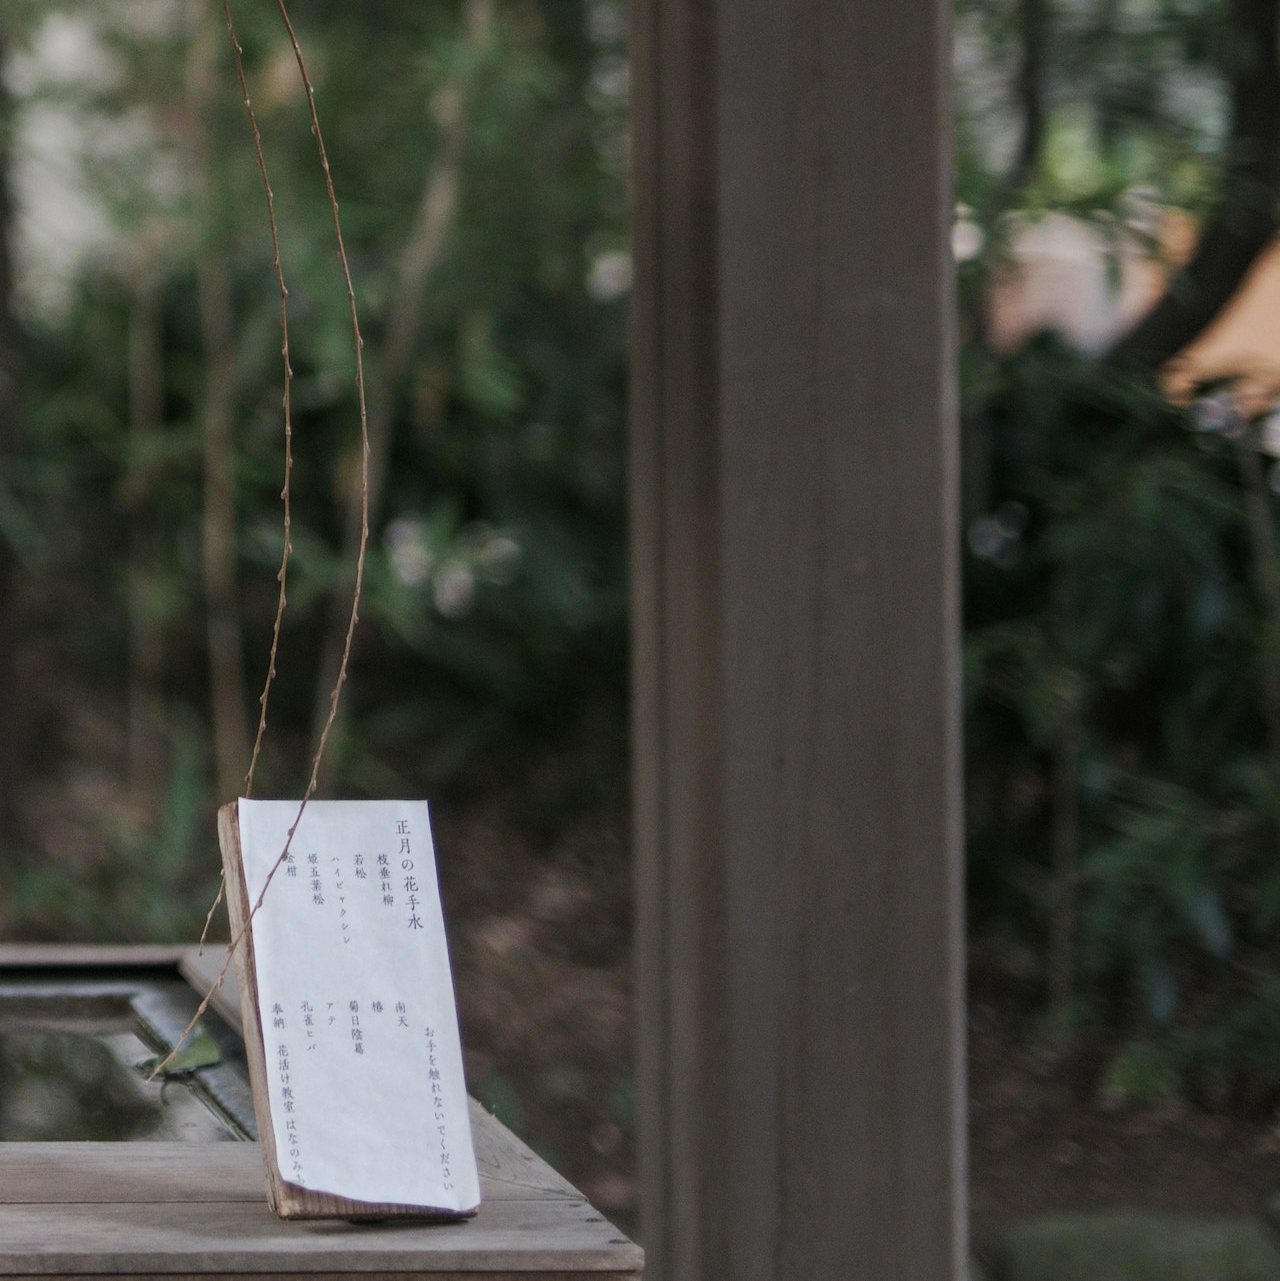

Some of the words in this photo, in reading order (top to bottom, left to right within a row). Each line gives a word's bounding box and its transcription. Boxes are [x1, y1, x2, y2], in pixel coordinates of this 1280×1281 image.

[353, 854, 367, 879] 若松
[376, 853, 394, 907] 枝垂れ柳
[395, 819, 424, 930] 正月の花手水
[331, 856, 350, 944] ハイビャクシン
[271, 1002, 285, 1029] 奉納
[300, 1000, 316, 1051] 孔雀ヒバ
[326, 1002, 336, 1027] アテ
[371, 1001, 384, 1012] 椿
[395, 1001, 408, 1028] 南天
[277, 1045, 295, 1114] 花活け教室
[424, 1027, 454, 1191] お手を触れないでください
